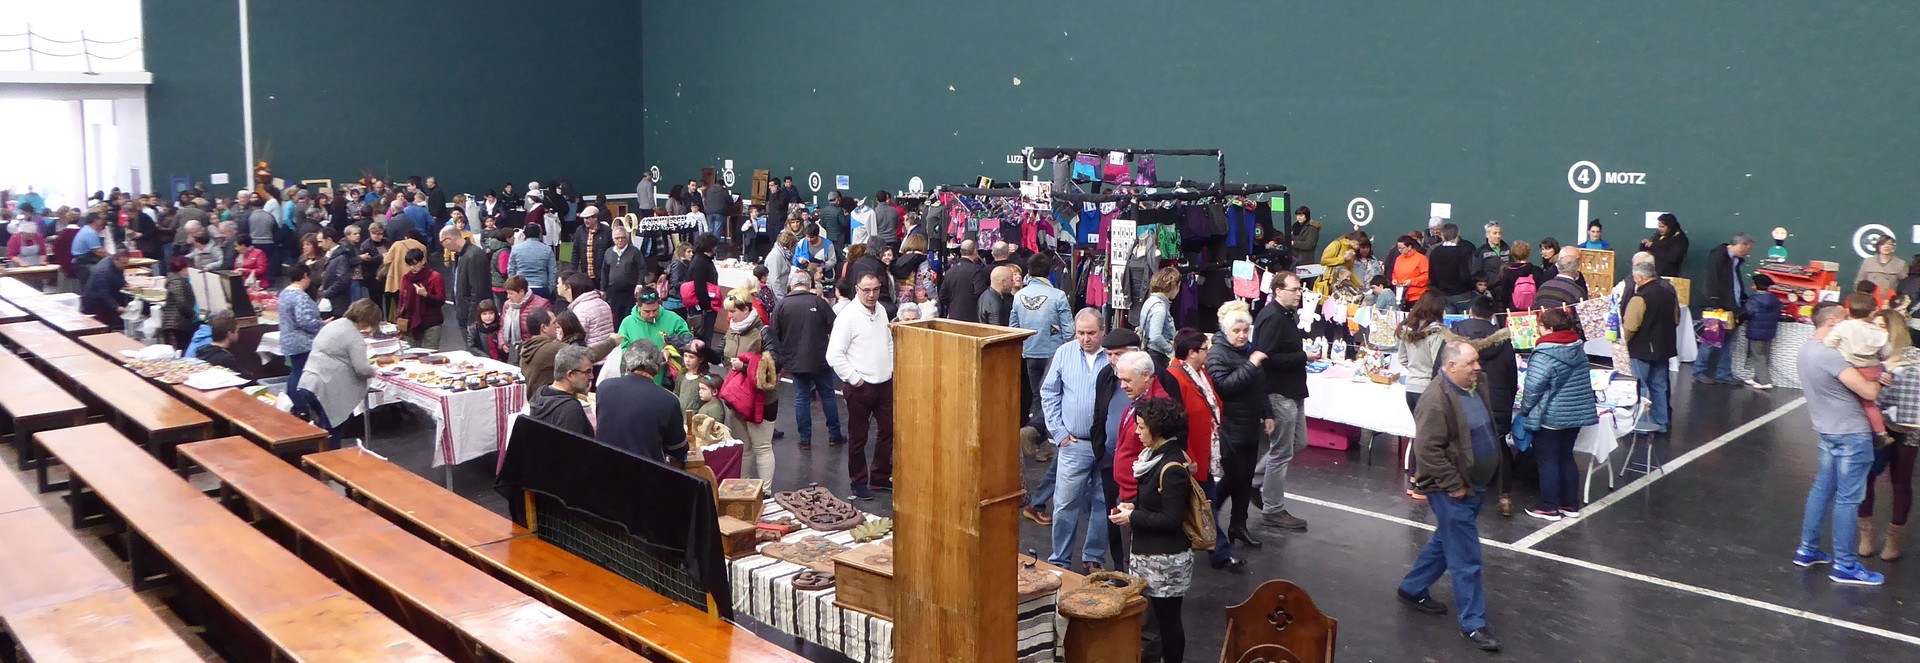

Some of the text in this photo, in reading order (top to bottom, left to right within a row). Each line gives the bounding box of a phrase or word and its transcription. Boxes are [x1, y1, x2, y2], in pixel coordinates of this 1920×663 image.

[726, 173, 732, 182] 10
[812, 176, 818, 187] 9
[1578, 169, 1646, 184] 4 MOTZ
[1355, 205, 1365, 219] 5
